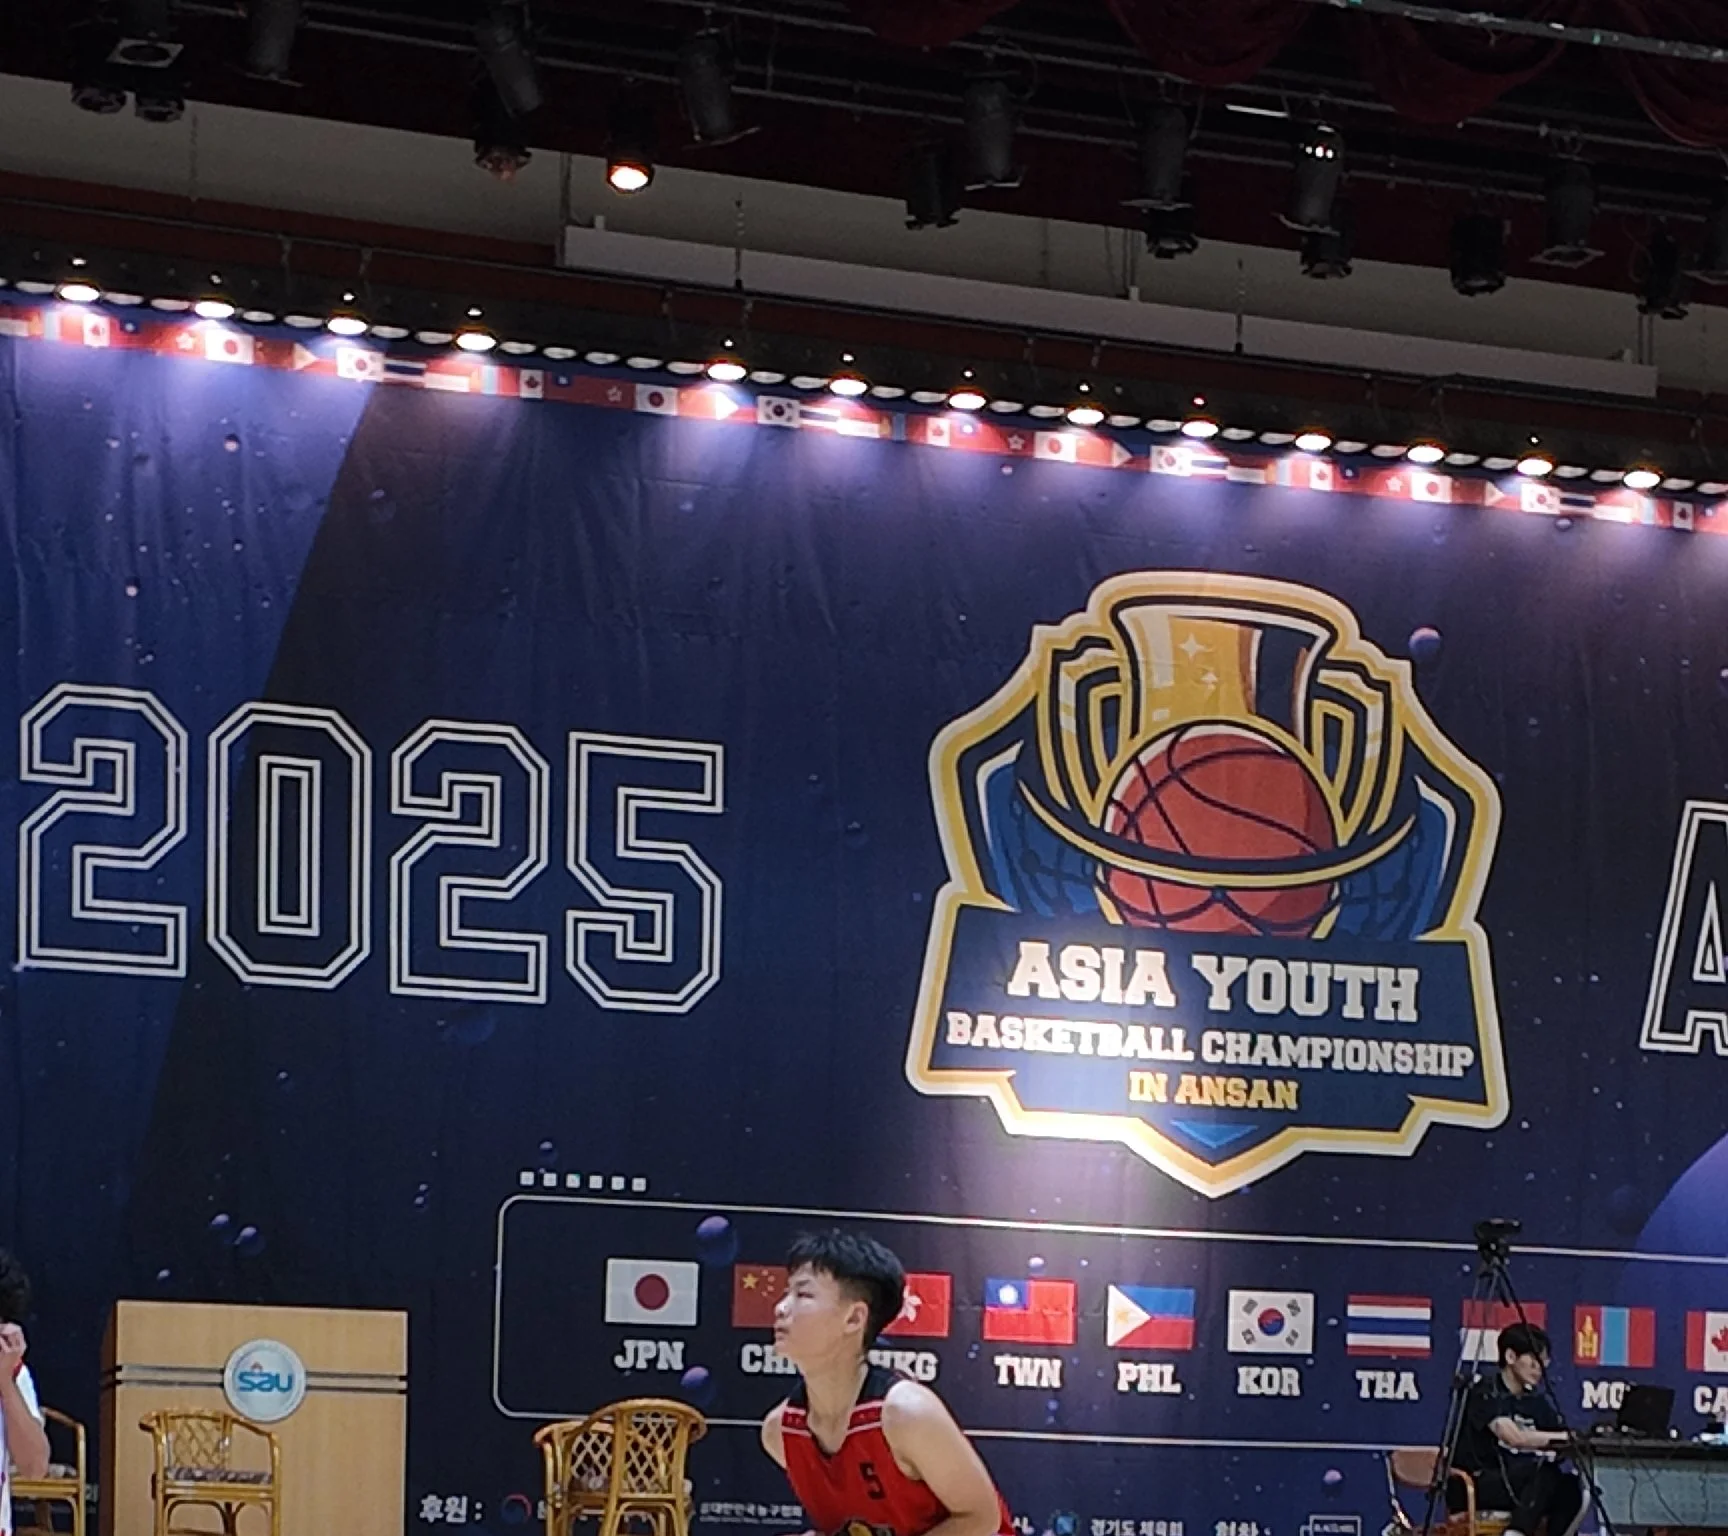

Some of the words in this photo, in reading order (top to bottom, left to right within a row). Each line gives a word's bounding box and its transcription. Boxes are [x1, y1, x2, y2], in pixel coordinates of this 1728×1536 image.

[19, 682, 725, 1014] 2025
[1007, 941, 1177, 1008] ASIA
[1191, 954, 1420, 1023] YOUTH
[946, 1011, 1195, 1063] BASKETBALL
[1201, 1030, 1475, 1077] CHAMPIONSHIP
[1128, 1070, 1168, 1104] IN
[1174, 1073, 1299, 1111] ANSAN
[613, 1339, 685, 1371] JPN
[993, 1354, 1063, 1388] TWN
[1117, 1361, 1182, 1394] PHL
[1237, 1365, 1300, 1396] KOR
[1355, 1369, 1419, 1400] THA
[859, 1462, 887, 1500] 5
